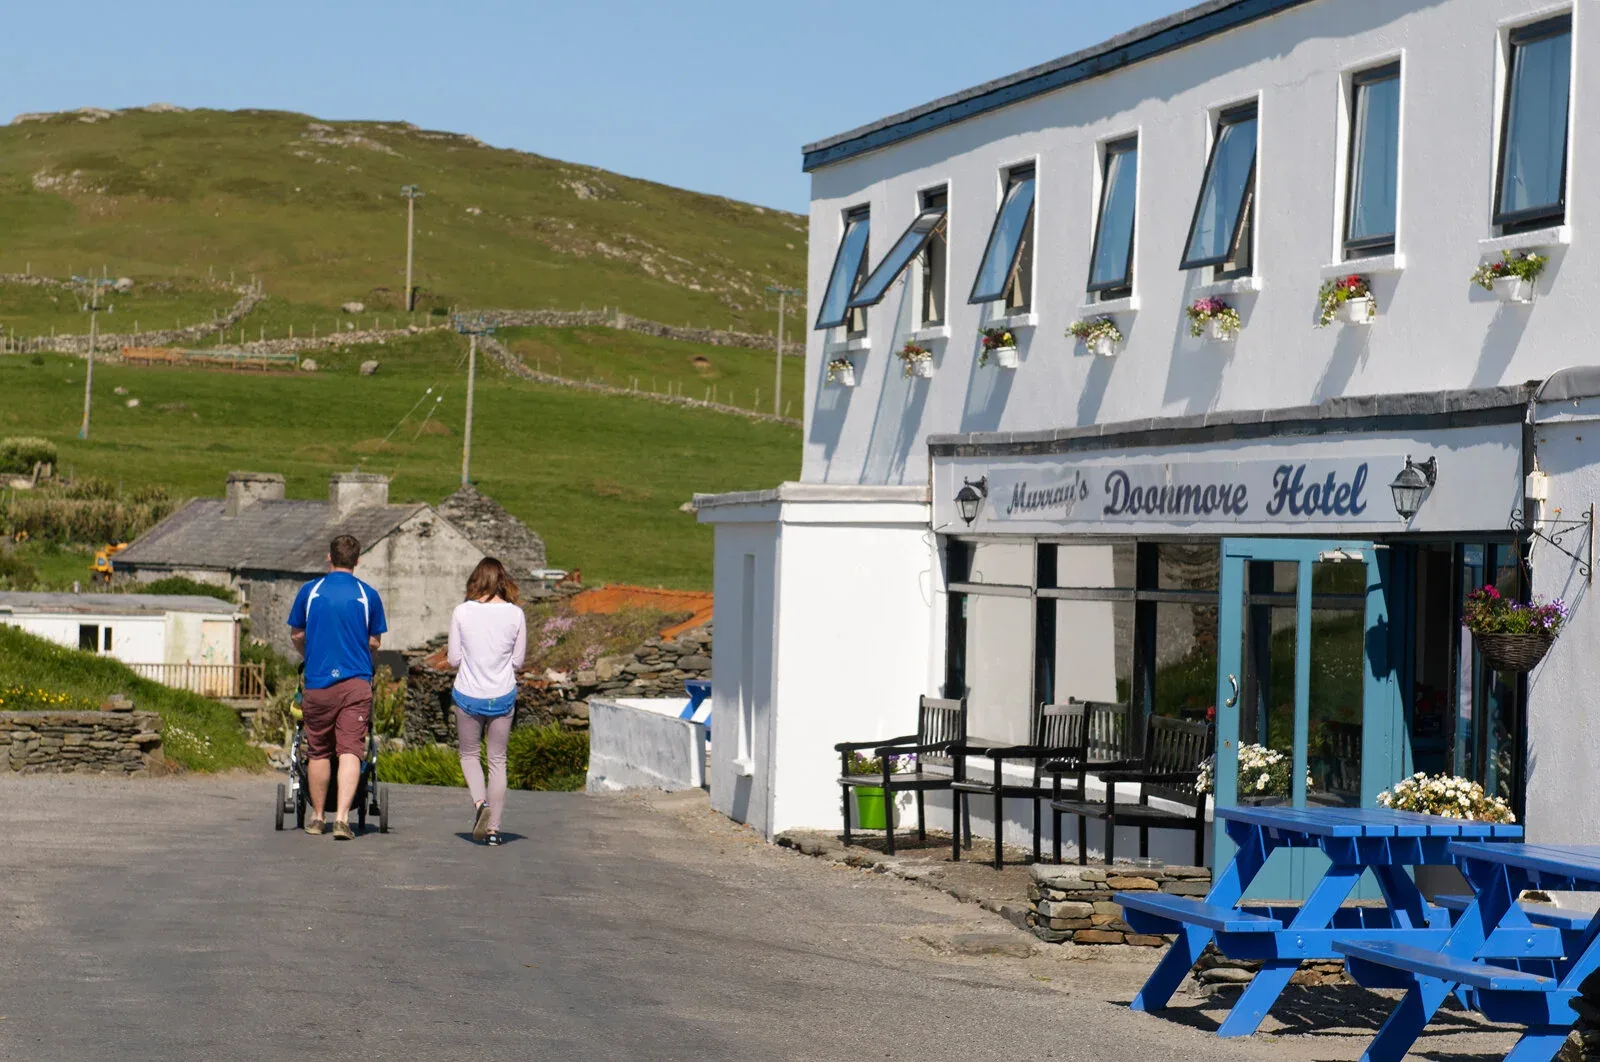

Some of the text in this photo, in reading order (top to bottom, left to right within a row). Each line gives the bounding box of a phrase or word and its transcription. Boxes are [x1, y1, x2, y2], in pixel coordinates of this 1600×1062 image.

[1007, 463, 1369, 517] Murray's Doonmore Hotel
